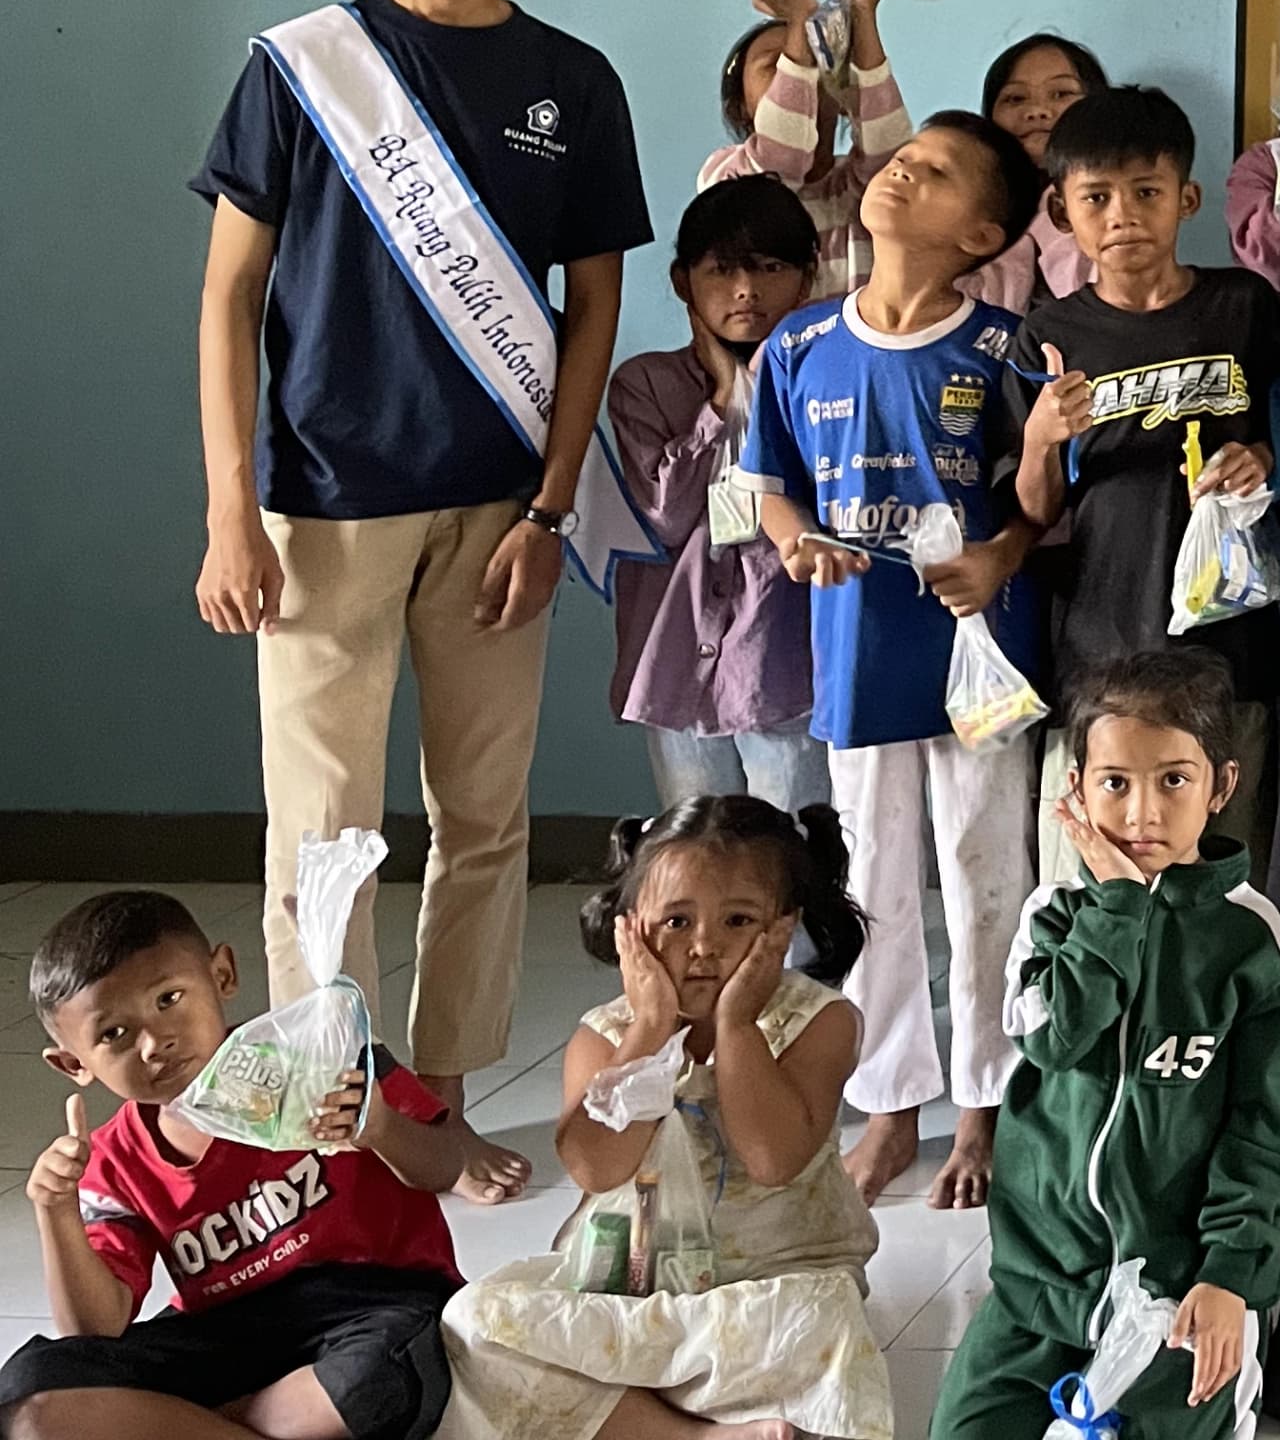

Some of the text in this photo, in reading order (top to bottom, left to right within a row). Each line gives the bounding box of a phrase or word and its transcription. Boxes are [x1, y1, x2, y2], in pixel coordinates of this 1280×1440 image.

[395, 179, 451, 258] Ruang
[440, 254, 503, 322] Pulih
[1088, 361, 1230, 418] AHMA
[221, 1046, 283, 1091] Pilus
[1143, 1034, 1216, 1079] 45
[229, 1254, 270, 1288] EVERY
